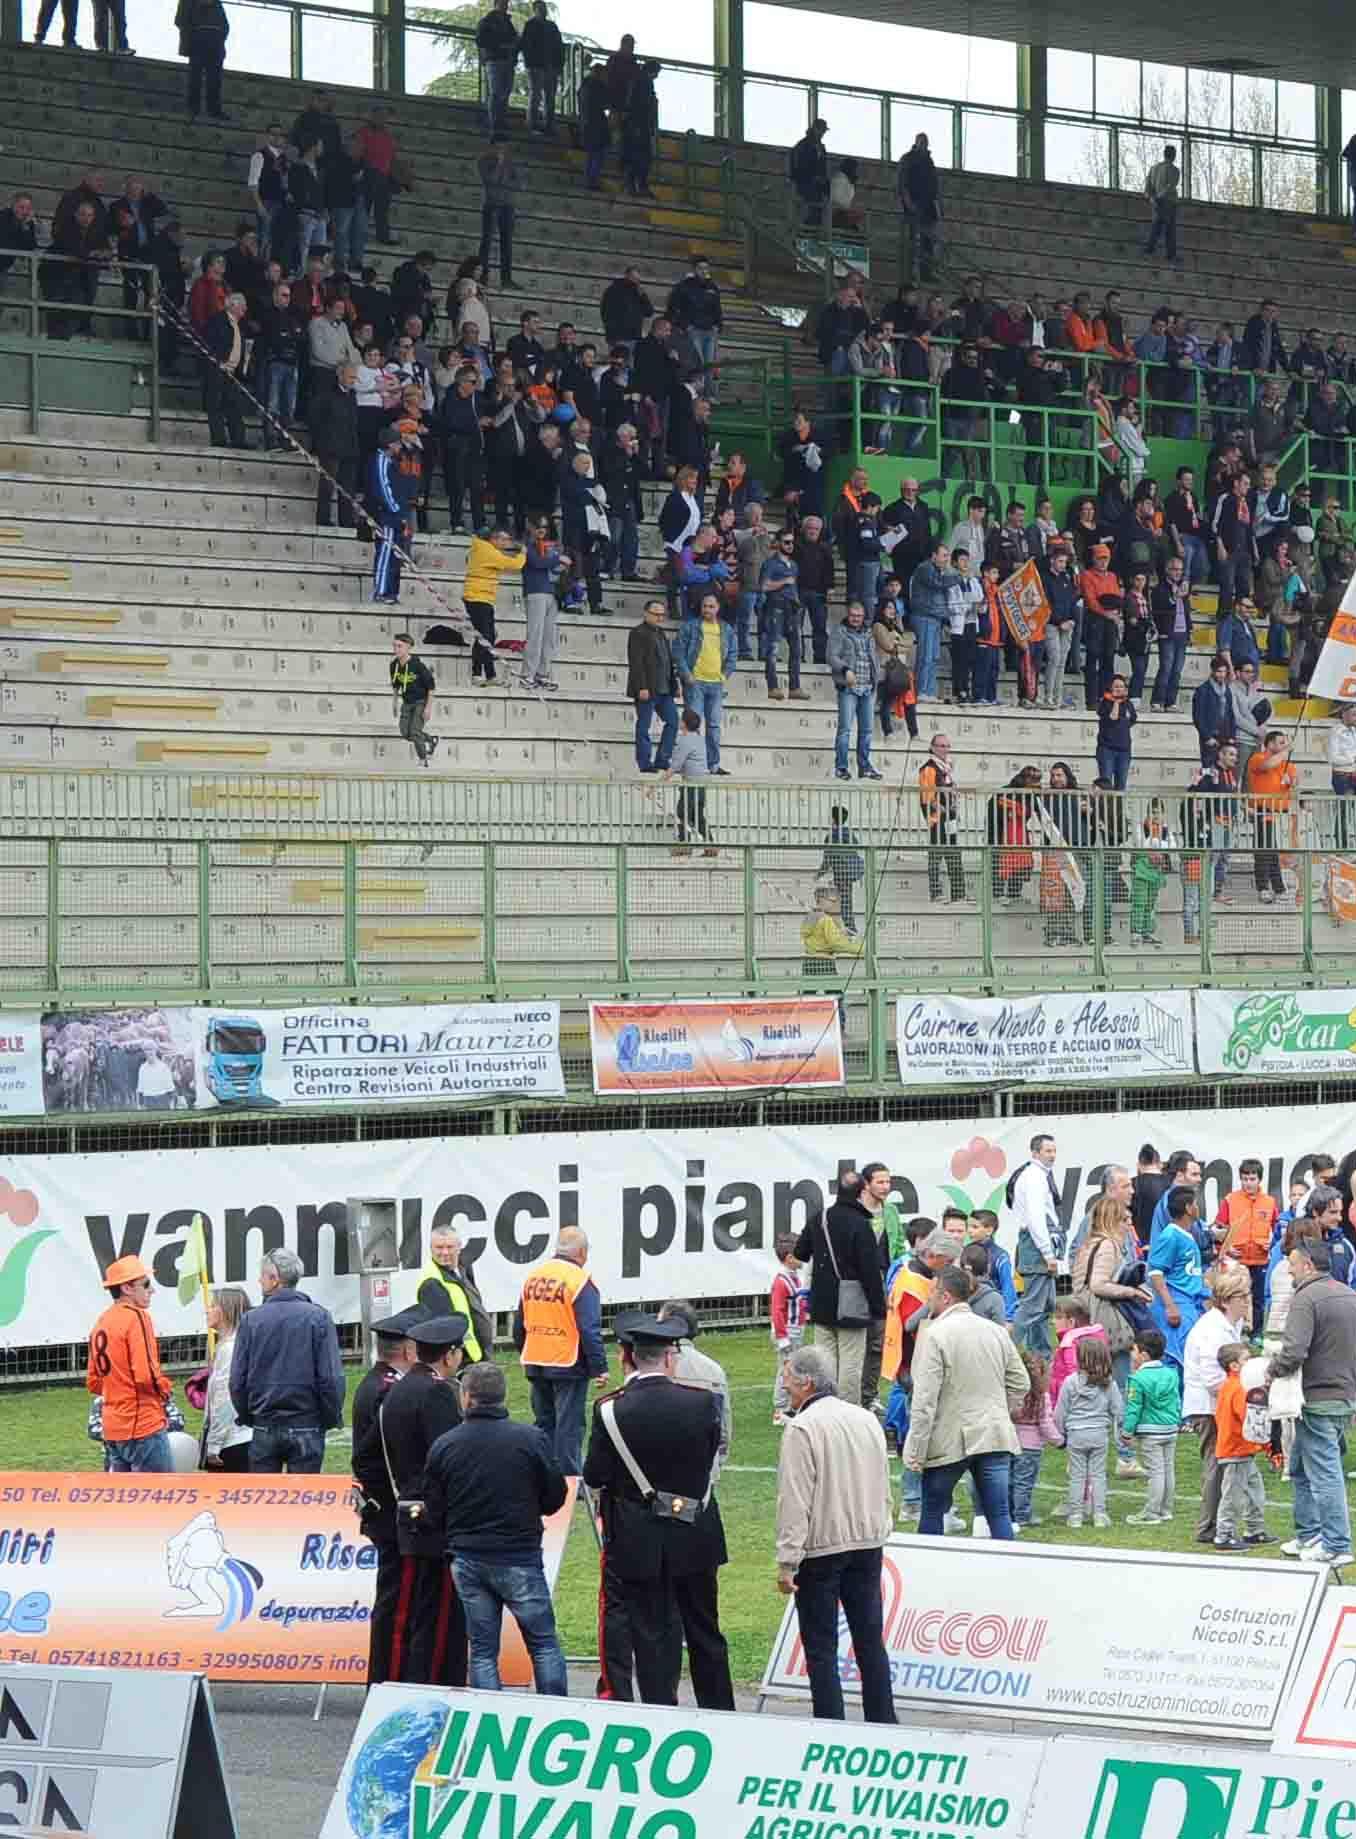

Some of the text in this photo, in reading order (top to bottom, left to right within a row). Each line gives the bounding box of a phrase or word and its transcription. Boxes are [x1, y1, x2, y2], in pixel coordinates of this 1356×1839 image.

[284, 1015, 369, 1029] Officina
[514, 1012, 551, 1023] IVECO
[1074, 1000, 1140, 1036] Alessio
[282, 1028, 552, 1055] FATTORI Maurizio
[906, 1041, 988, 1056] LAVORAZIONI
[1007, 1042, 1047, 1056] FERRO
[1062, 1038, 1110, 1052] ACCIAIO
[1115, 1037, 1142, 1050] INOX
[1296, 1022, 1342, 1049] car
[293, 1056, 547, 1080] Riparazione Veicoli Industriali
[294, 1076, 537, 1095] Centro Revisioni Autorizzato
[31, 1488, 60, 1502] Tel.
[68, 1487, 198, 1504] 05731974475
[216, 1490, 336, 1506] 3457222649
[300, 1532, 379, 1570] Risa
[1200, 1603, 1297, 1627] Costruzioni
[1192, 1625, 1289, 1648] Niccoli S.r.l.
[10, 1650, 41, 1663] Tel.
[50, 1650, 181, 1667] 05741821163
[203, 1653, 324, 1670] 3299508075
[1046, 1686, 1270, 1720] www.costruzioniniccoli.com
[434, 1710, 713, 1799] INGRO
[801, 1743, 968, 1785] PRODOTTI
[736, 1776, 1009, 1828] PER IL VIVAISMO
